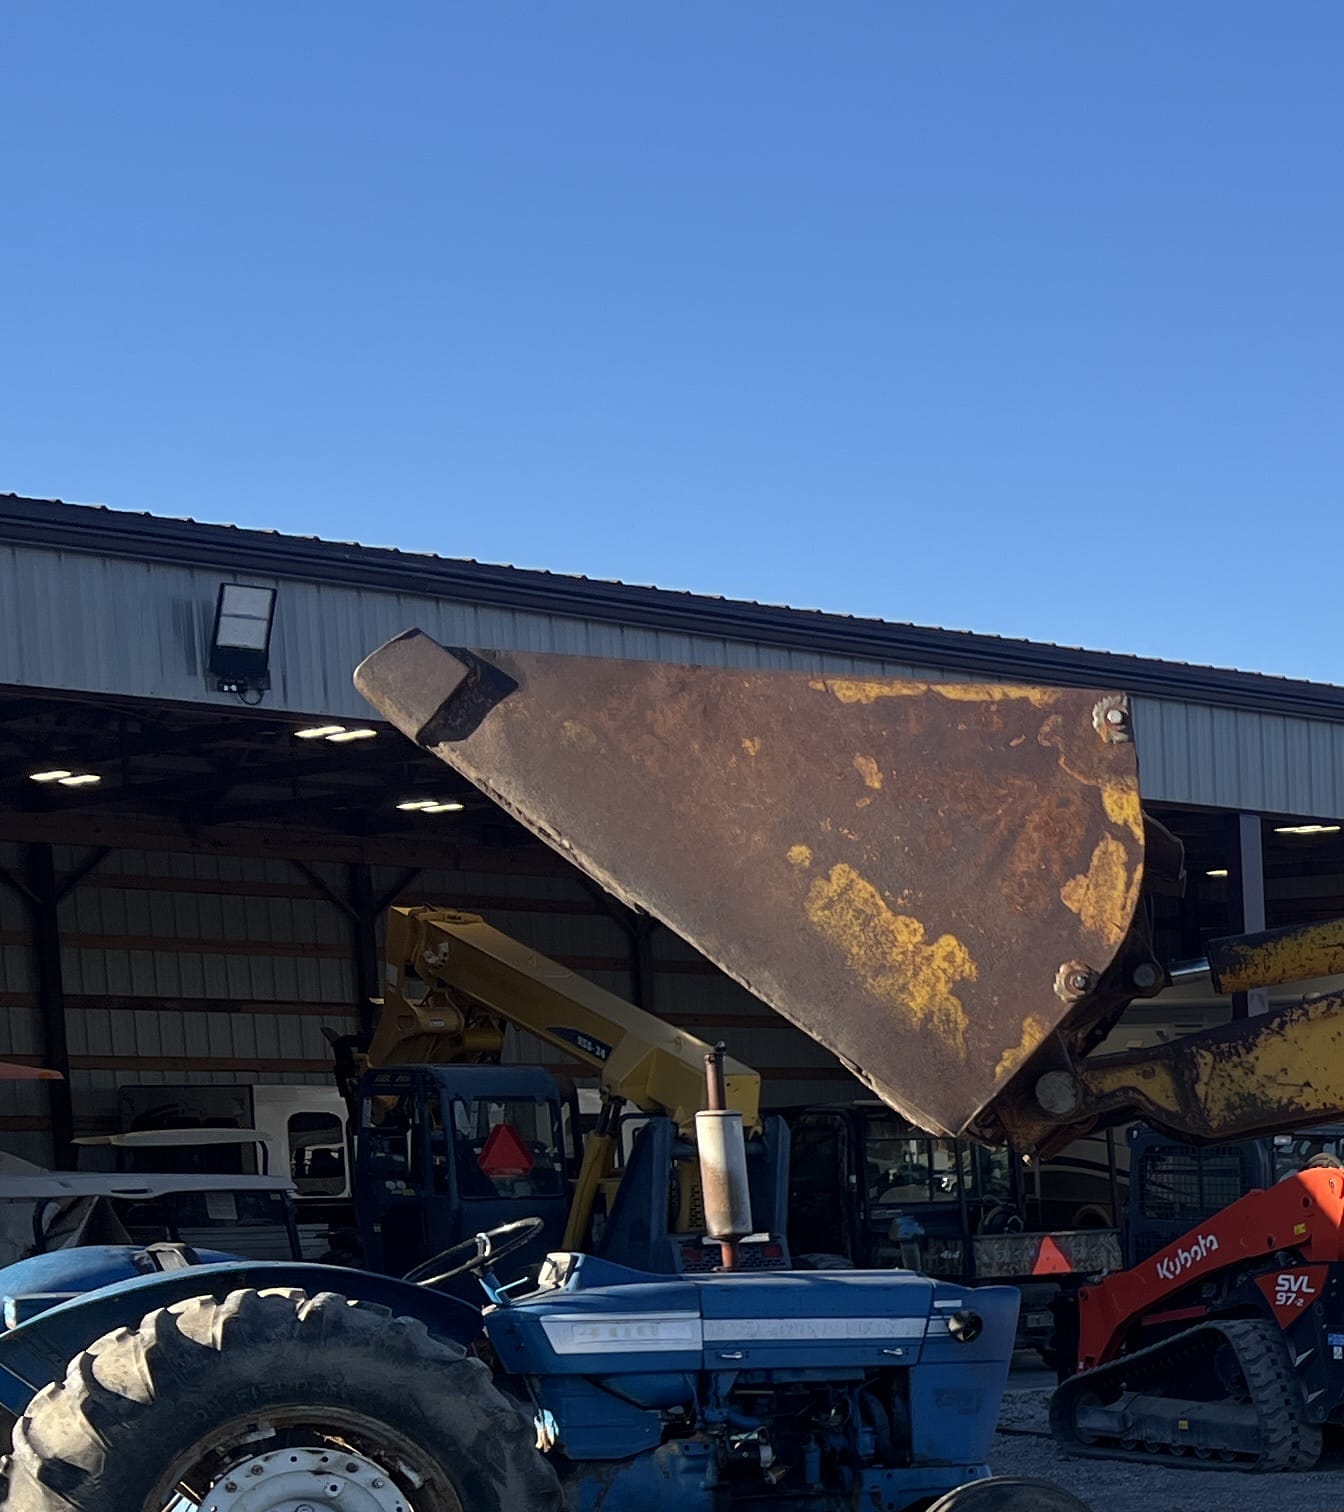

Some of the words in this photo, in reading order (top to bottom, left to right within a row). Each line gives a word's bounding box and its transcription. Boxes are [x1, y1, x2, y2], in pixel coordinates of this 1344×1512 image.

[1156, 1234, 1218, 1279] Kubota
[1275, 1275, 1315, 1293] SVL
[1275, 1292, 1304, 1307] 97-2
